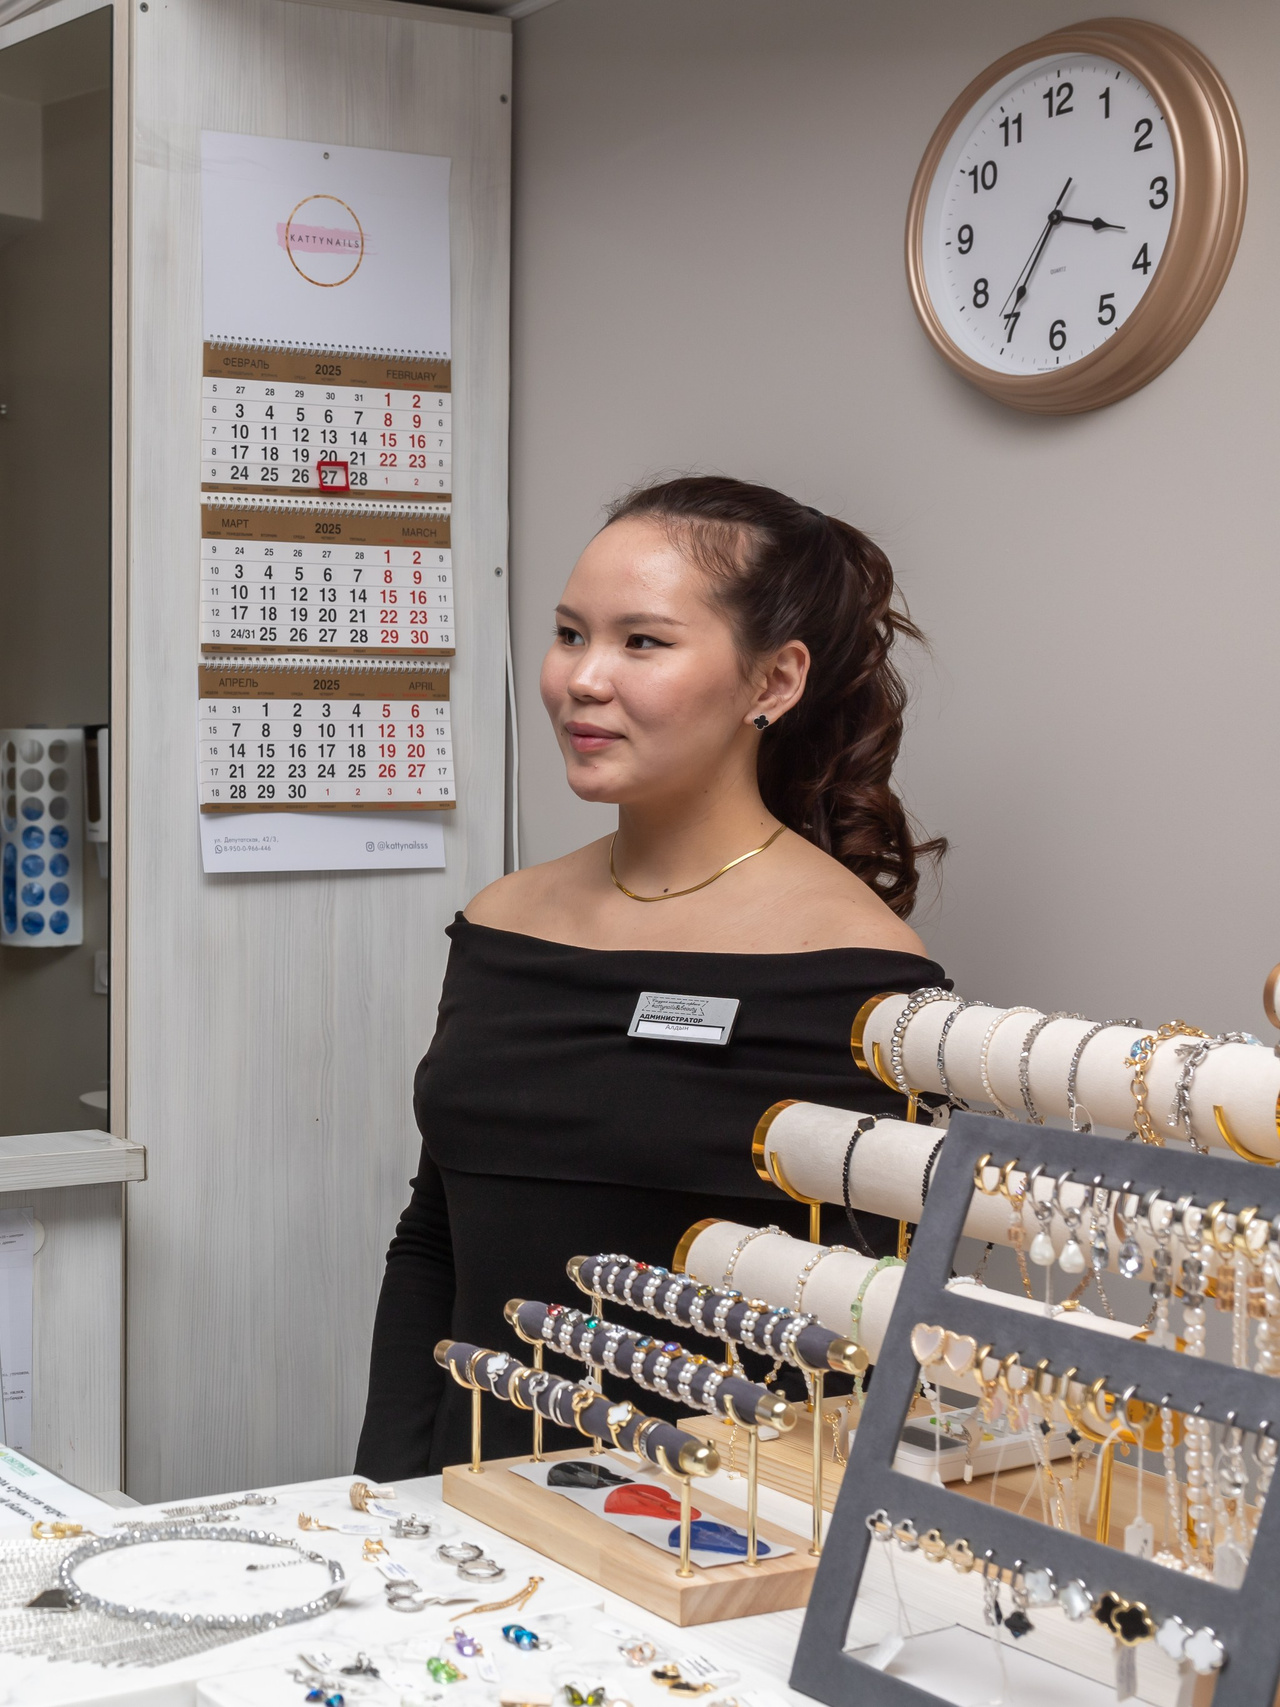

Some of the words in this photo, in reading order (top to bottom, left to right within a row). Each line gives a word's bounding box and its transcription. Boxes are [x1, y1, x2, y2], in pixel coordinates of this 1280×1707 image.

[1042, 82, 1074, 118] 12
[1099, 86, 1111, 119] 1
[999, 112, 1023, 147] 11
[1133, 118, 1153, 152] 2
[968, 160, 998, 194] 10
[1149, 176, 1168, 210] 3
[290, 233, 361, 249] KATTYNAILS
[957, 224, 974, 255] 9
[1132, 242, 1152, 275] 4
[1050, 266, 1067, 275] QUARTZ
[973, 278, 990, 309] 8
[1098, 293, 1116, 326] 5
[1003, 311, 1022, 343] 7
[1048, 319, 1067, 351] 6
[223, 357, 270, 370] ФЕВРАЛЬ
[315, 364, 342, 376] 2025
[386, 369, 437, 381] FEBRUARY
[265, 388, 275, 396] 28
[295, 390, 304, 398] 29
[326, 392, 335, 400] 30
[385, 393, 390, 406] 1
[413, 395, 420, 408] 2
[236, 404, 244, 418] 3
[265, 406, 274, 419] 4
[297, 407, 304, 422] 5
[325, 409, 333, 423] 6
[355, 411, 363, 425] 7
[384, 413, 392, 427] 8
[413, 415, 421, 428] 9
[231, 424, 249, 439] 10
[261, 426, 276, 440] 11
[293, 428, 309, 442] 12
[321, 429, 337, 444] 13
[351, 431, 367, 445] 14
[380, 433, 397, 447] 15
[409, 434, 426, 448] 16
[231, 445, 249, 459] 17
[261, 446, 278, 461] 18
[293, 448, 309, 462] 19
[320, 450, 338, 463] 20
[350, 451, 365, 465] 21
[380, 453, 397, 467] 22
[409, 454, 426, 468] 23
[231, 465, 249, 480] 24
[261, 467, 278, 482] 25
[292, 468, 309, 483] 26
[321, 471, 338, 485] 27
[350, 471, 367, 486] 28
[221, 518, 249, 529] МАРТ
[315, 523, 342, 535] 2025
[402, 527, 437, 538] MARCH
[265, 548, 273, 556] 25
[384, 550, 390, 563] 1
[413, 551, 421, 564] 2
[235, 564, 243, 579] 3
[264, 565, 273, 579] 4
[295, 567, 303, 581] 5
[324, 568, 332, 582] 6
[354, 569, 362, 582] 7
[384, 570, 392, 583] 8
[413, 571, 422, 584] 9
[231, 585, 248, 599] 10
[260, 586, 275, 600] 11
[291, 587, 307, 601] 12
[320, 588, 336, 602] 13
[350, 589, 367, 603] 14
[380, 590, 397, 604] 15
[410, 591, 427, 604] 16
[231, 605, 248, 620] 17
[260, 606, 277, 621] 18
[291, 607, 307, 622] 19
[319, 608, 336, 622] 20
[350, 609, 365, 623] 21
[380, 610, 398, 623] 22
[410, 610, 427, 624] 23
[231, 629, 255, 639] 24/31
[260, 627, 277, 641] 25
[290, 628, 307, 642] 26
[319, 628, 337, 642] 27
[350, 629, 368, 643] 28
[381, 630, 398, 643] 29
[411, 630, 428, 644] 30
[219, 678, 259, 688] АПРЕЛЬ
[313, 679, 340, 691] 2025
[408, 681, 435, 691] APRIL
[262, 703, 268, 717] 1
[293, 703, 301, 717] 2
[322, 703, 330, 717] 3
[352, 704, 361, 717] 4
[382, 704, 390, 718] 5
[411, 704, 419, 718] 6
[232, 723, 241, 737] 7
[262, 723, 270, 737] 8
[293, 723, 301, 737] 9
[318, 724, 335, 737] 10
[349, 724, 363, 737] 11
[379, 724, 395, 737] 12
[408, 724, 424, 738] 13
[229, 744, 245, 757] 14
[258, 744, 275, 758] 15
[289, 744, 306, 758] 16
[318, 744, 335, 757] 17
[349, 744, 366, 758] 18
[379, 744, 396, 758] 19
[408, 744, 425, 758] 20
[229, 764, 244, 778] 21
[257, 764, 275, 778] 22
[288, 764, 306, 778] 23
[318, 764, 335, 778] 24
[348, 764, 366, 778] 25
[379, 764, 396, 778] 26
[408, 764, 425, 777] 27
[230, 785, 246, 799] 28
[258, 784, 275, 798] 29
[288, 784, 306, 798] 30
[376, 841, 428, 851] @kattynailsss
[640, 1013, 704, 1024] АДМИНИСТРАТОР
[7, 1485, 44, 1506] средств
[42, 1504, 69, 1519] чере
